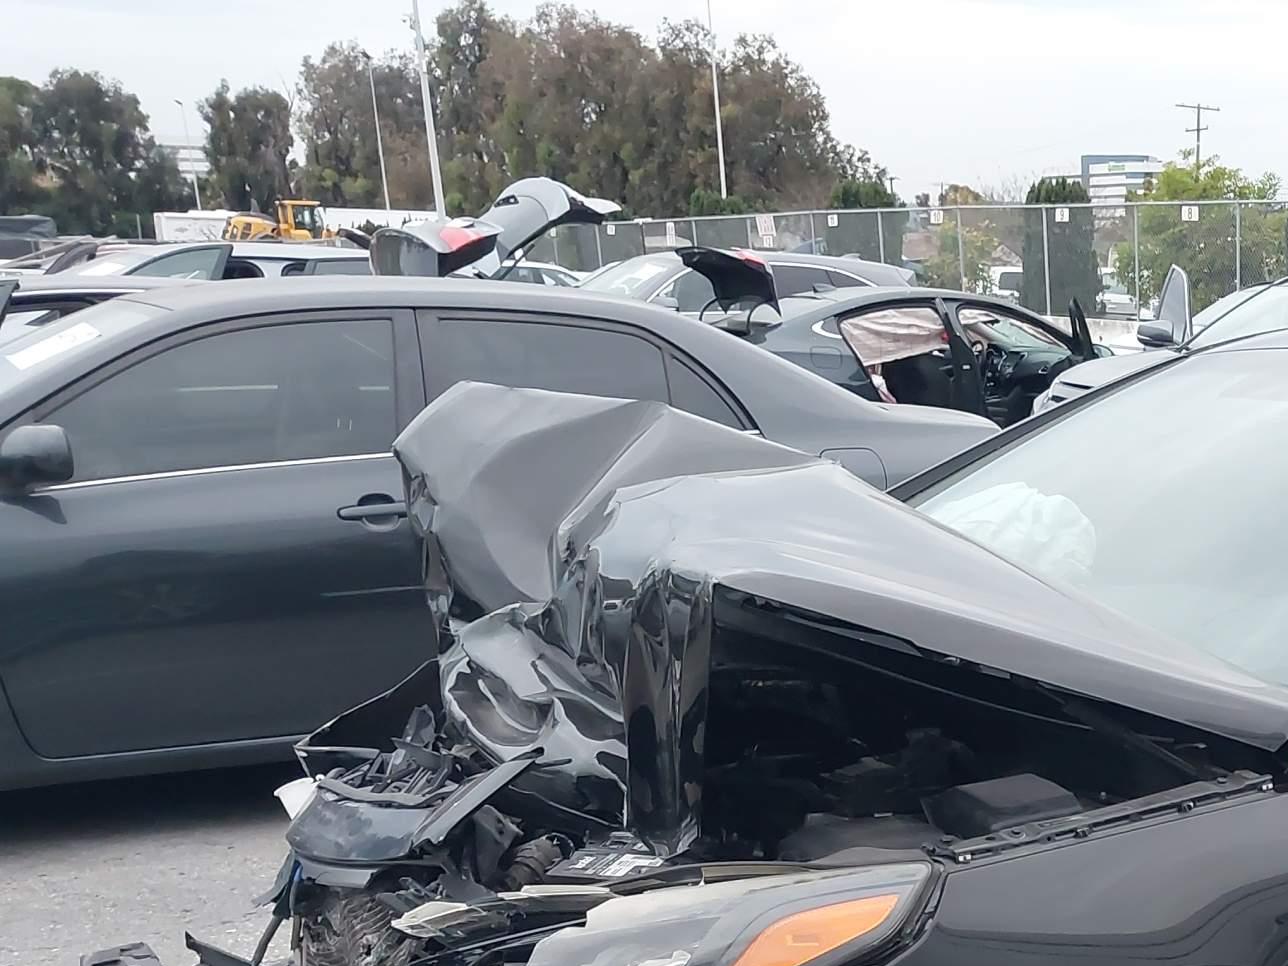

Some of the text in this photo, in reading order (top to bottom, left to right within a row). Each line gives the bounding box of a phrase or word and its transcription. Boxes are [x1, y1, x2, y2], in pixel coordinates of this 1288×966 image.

[933, 211, 941, 223] 10
[1059, 209, 1065, 222] 9
[1186, 207, 1194, 220] 8
